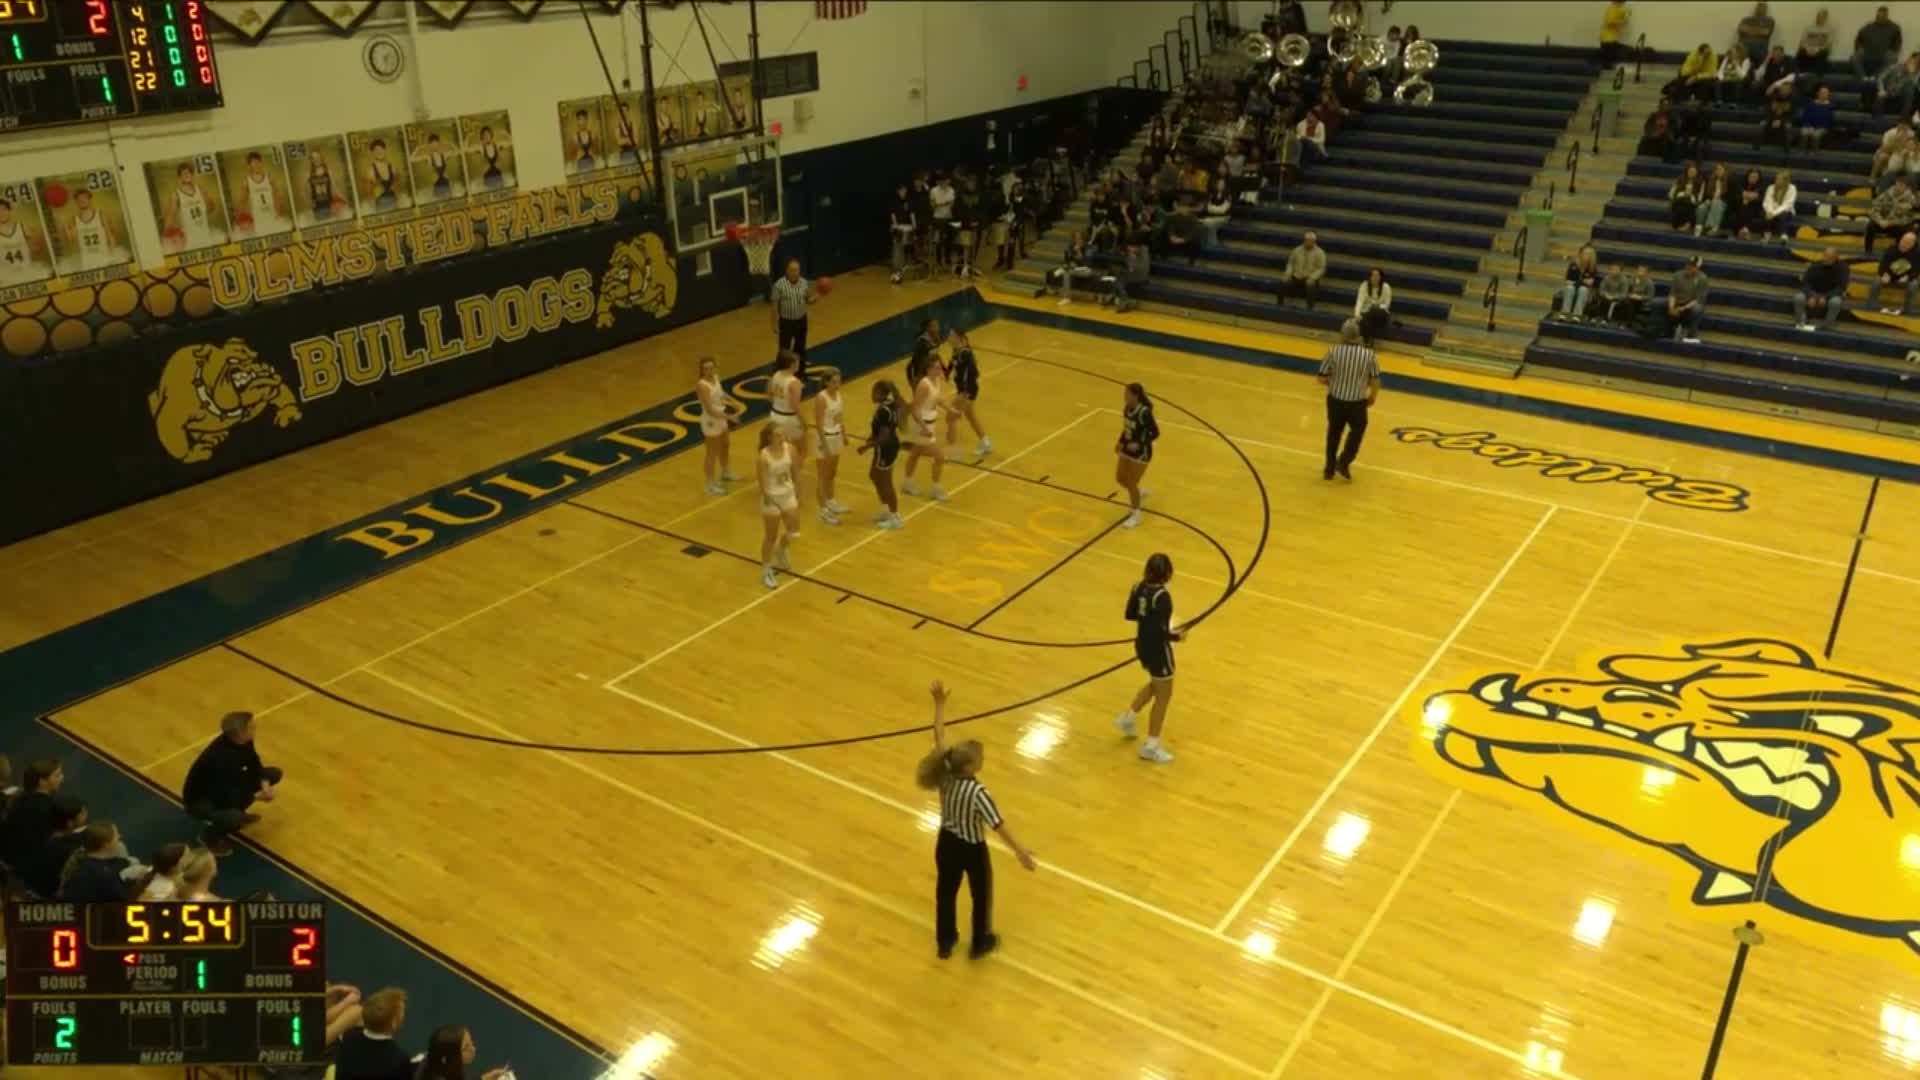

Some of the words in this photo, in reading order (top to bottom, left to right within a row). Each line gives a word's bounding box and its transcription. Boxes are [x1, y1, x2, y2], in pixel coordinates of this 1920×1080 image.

[86, 0, 107, 34] 2
[131, 6, 145, 22] 4
[165, 3, 173, 20] 1
[188, 1, 199, 19] 2
[131, 28, 148, 45] 12
[164, 25, 176, 43] 0
[192, 24, 203, 41] 0
[12, 33, 23, 61] 1
[129, 51, 154, 68] 21
[169, 47, 181, 65] 0
[196, 45, 207, 63] 0
[102, 77, 112, 102] 1
[135, 73, 157, 90] 22
[173, 69, 185, 87] 0
[200, 67, 211, 84] 0
[195, 155, 214, 174] 15
[87, 169, 113, 190] 32
[208, 211, 475, 310] OLMSTED
[486, 181, 620, 246] FALLS
[291, 267, 596, 402] BULLDOGS
[1390, 427, 1750, 512] Bulldogs
